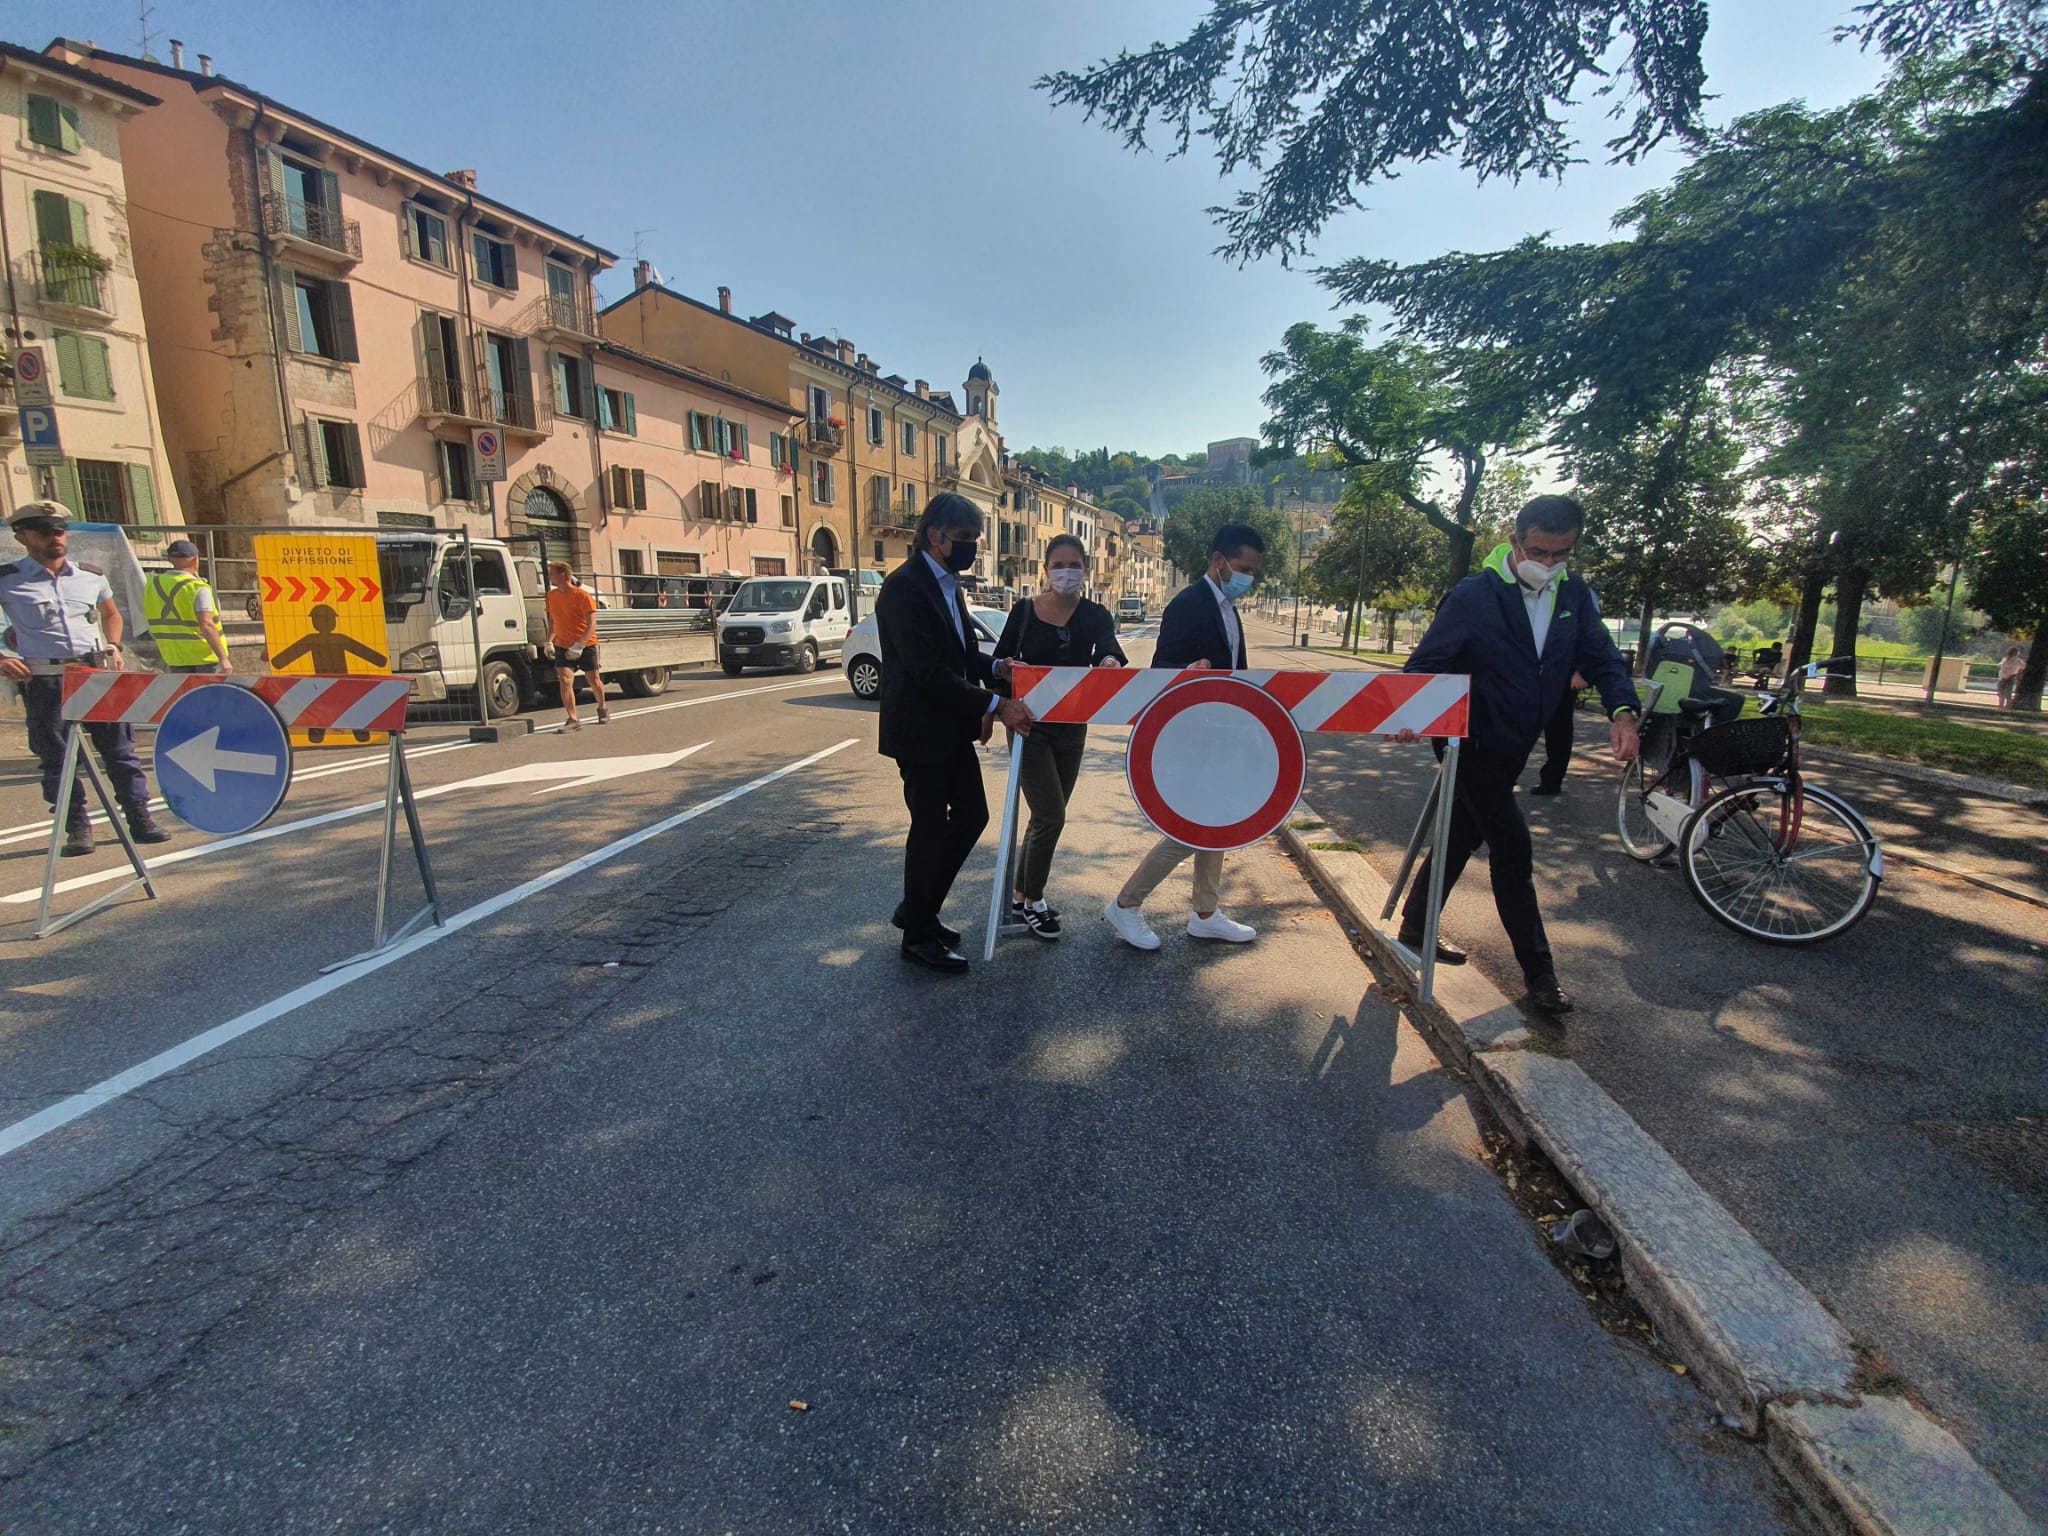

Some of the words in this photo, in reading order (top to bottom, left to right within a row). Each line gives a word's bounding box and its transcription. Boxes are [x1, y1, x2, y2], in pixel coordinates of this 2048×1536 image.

[26, 411, 49, 442] P
[282, 547, 332, 556] DIVIETO
[338, 547, 351, 556] DI
[281, 556, 354, 565] AFFISSIONE
